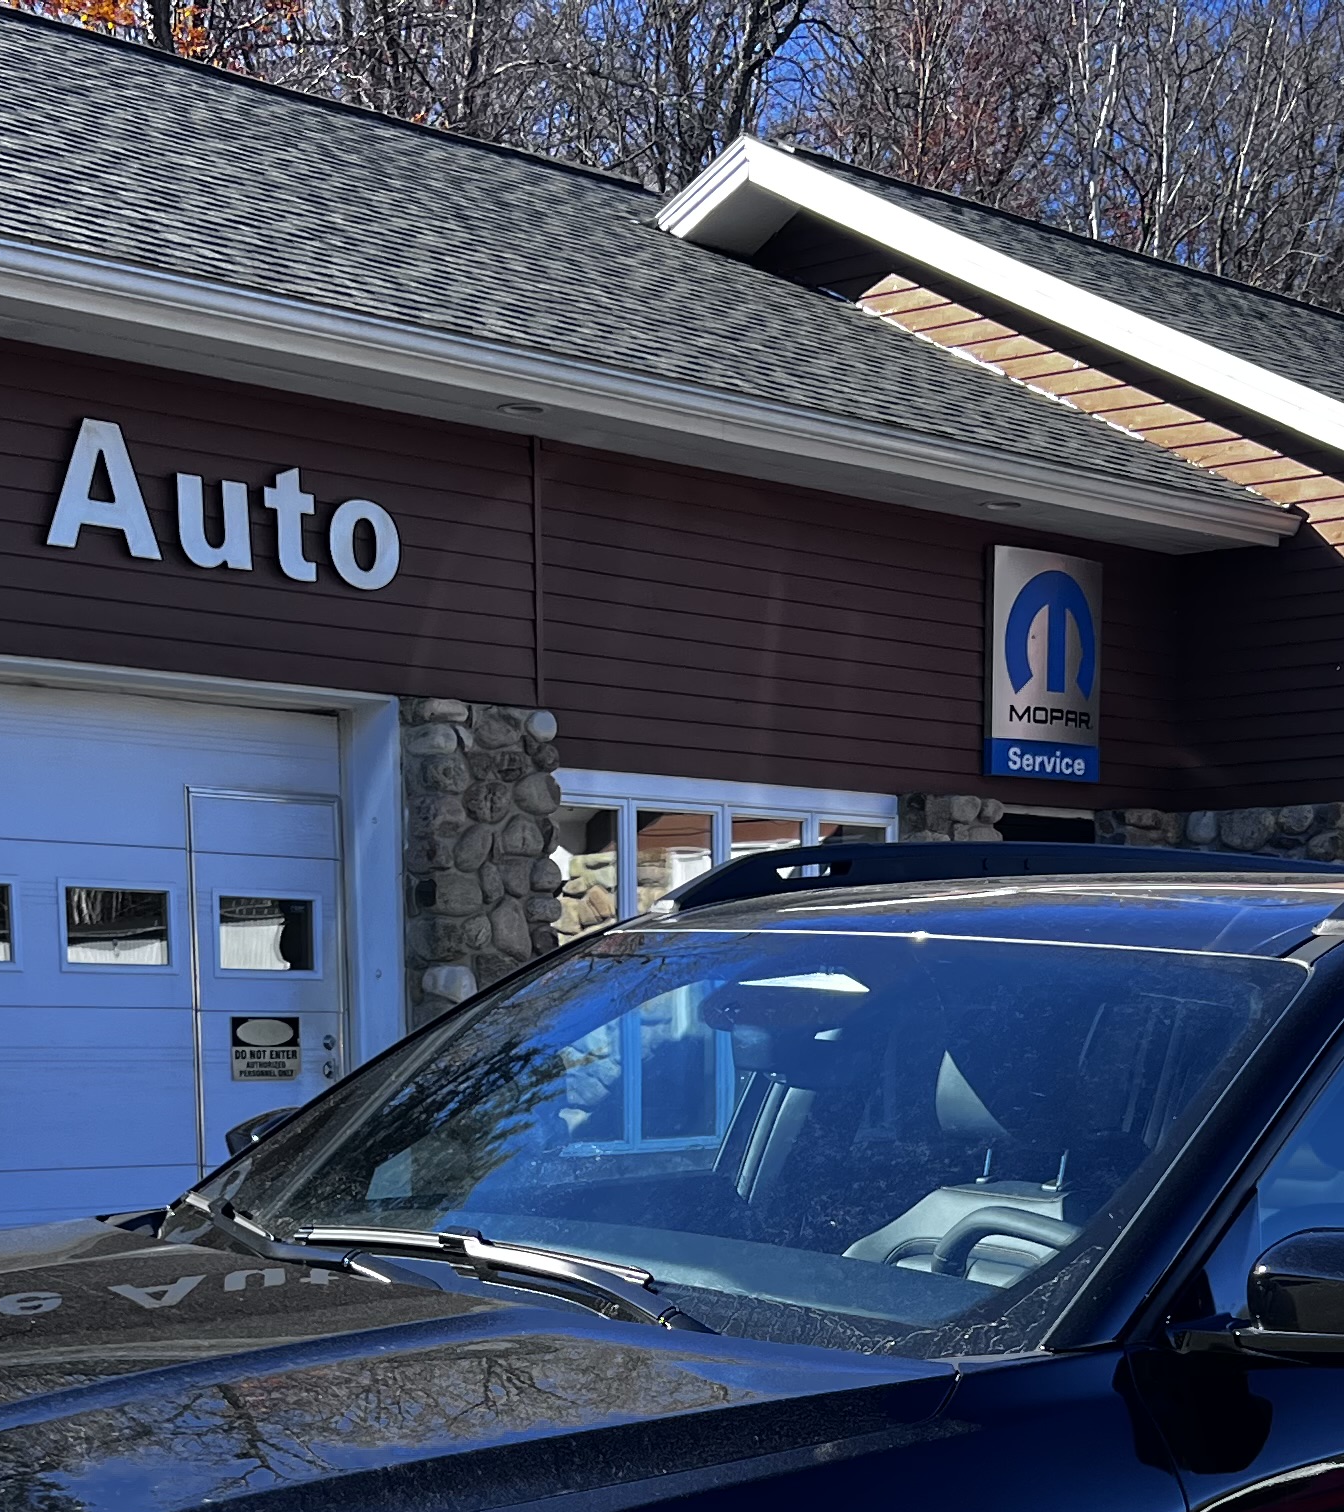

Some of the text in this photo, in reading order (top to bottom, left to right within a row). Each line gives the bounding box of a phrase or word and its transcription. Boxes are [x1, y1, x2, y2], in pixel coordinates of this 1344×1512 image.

[47, 417, 402, 591] Auto
[1009, 704, 1091, 729] MOPAR
[1008, 747, 1086, 776] Service
[235, 1050, 298, 1060] DO NOT ENTER
[246, 1061, 286, 1069] AUTHORIZED
[278, 1069, 294, 1077] ONLY
